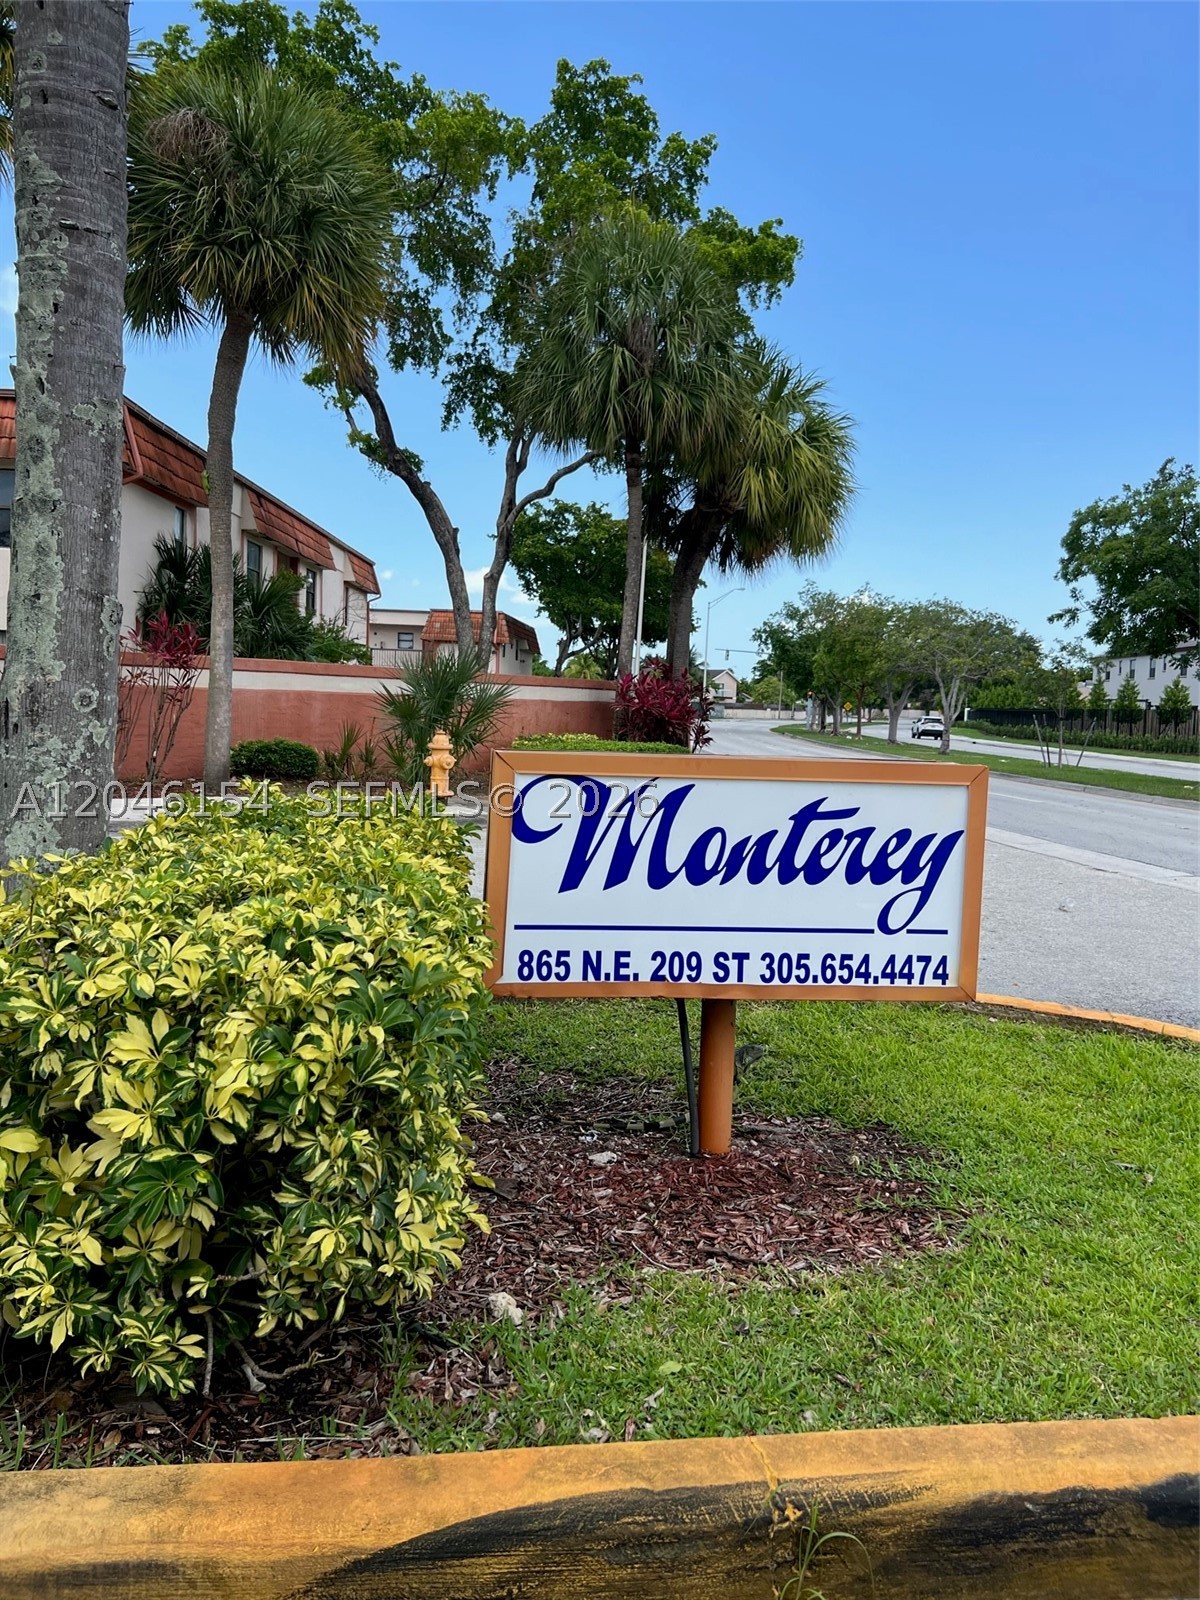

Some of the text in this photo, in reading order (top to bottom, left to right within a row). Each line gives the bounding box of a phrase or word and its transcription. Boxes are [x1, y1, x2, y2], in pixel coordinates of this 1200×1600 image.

[511, 774, 965, 935] Monterey
[517, 949, 949, 986] 865 N.E. 209 ST 305.654.4474
